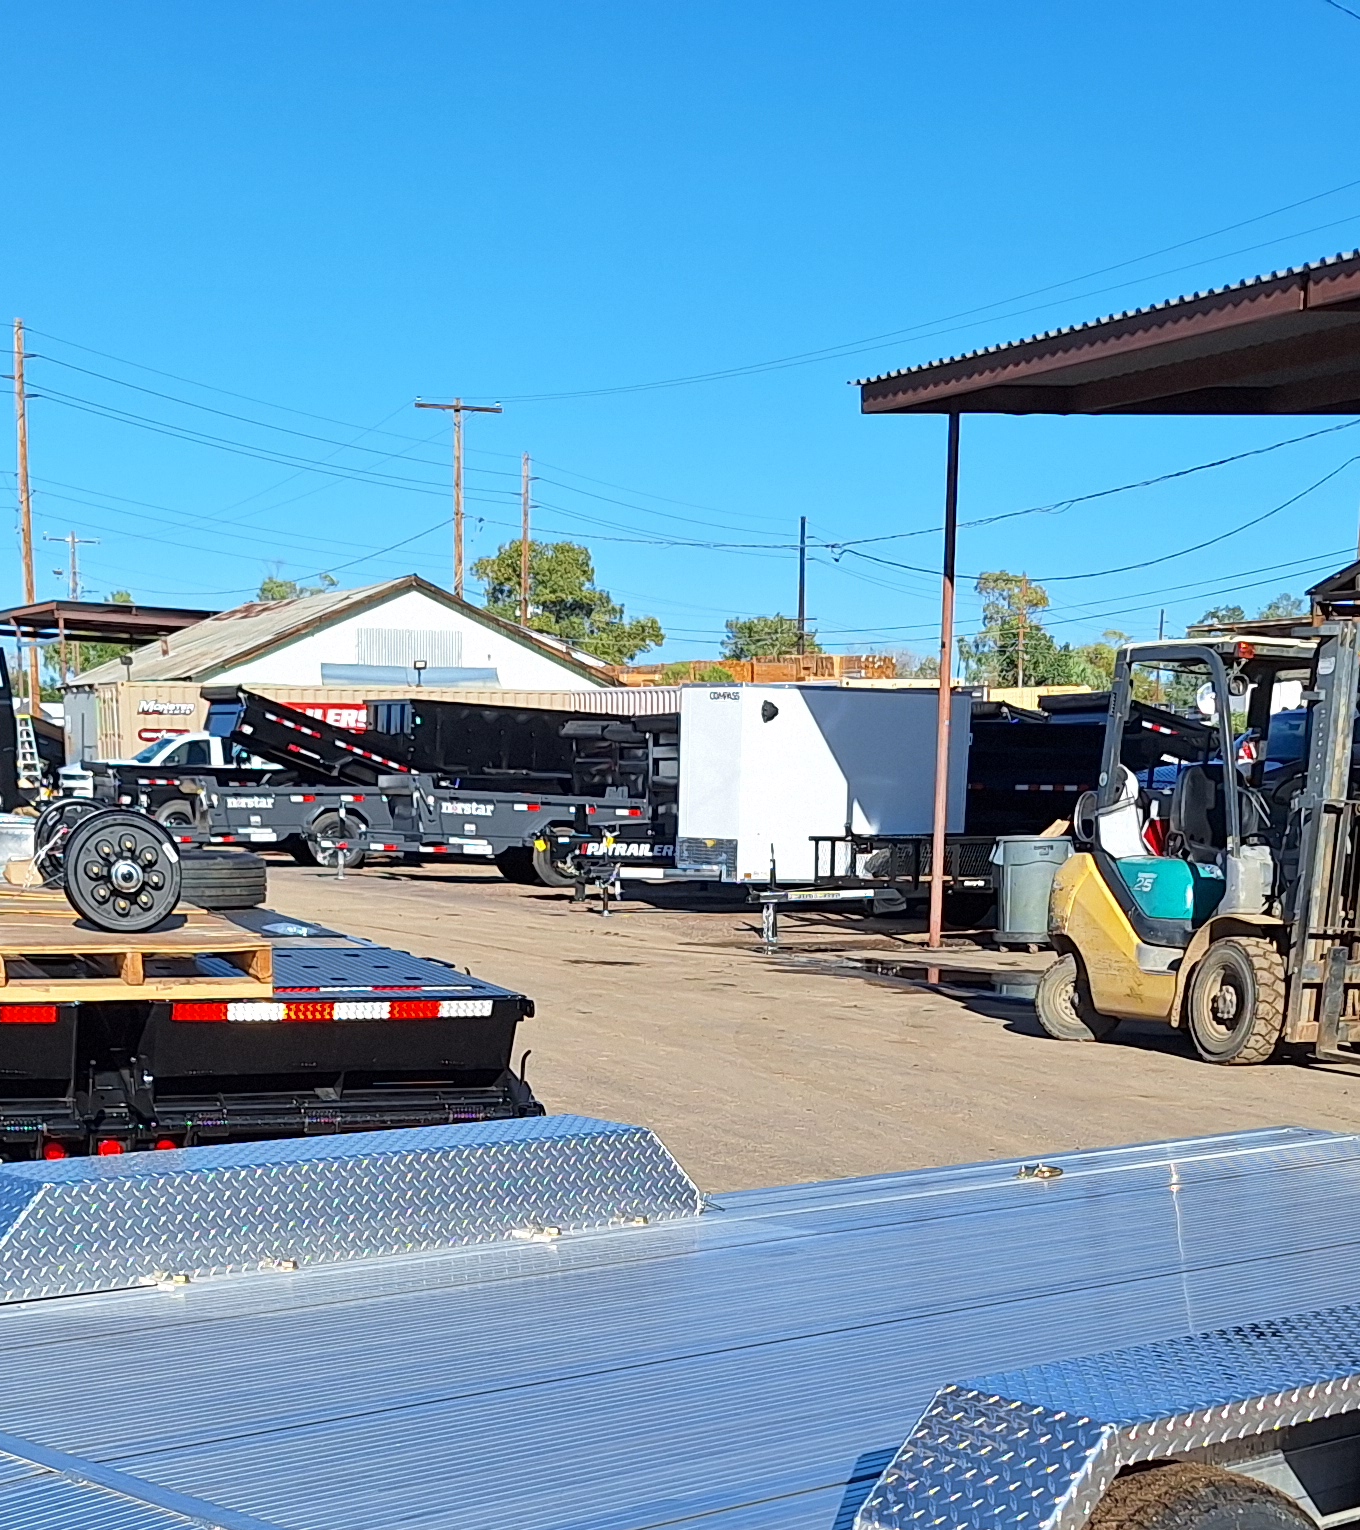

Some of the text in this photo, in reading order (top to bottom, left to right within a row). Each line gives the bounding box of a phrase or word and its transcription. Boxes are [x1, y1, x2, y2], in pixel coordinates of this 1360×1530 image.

[709, 691, 740, 701] COMPASS
[606, 842, 677, 857] TRAILER
[1133, 876, 1154, 892] 25
